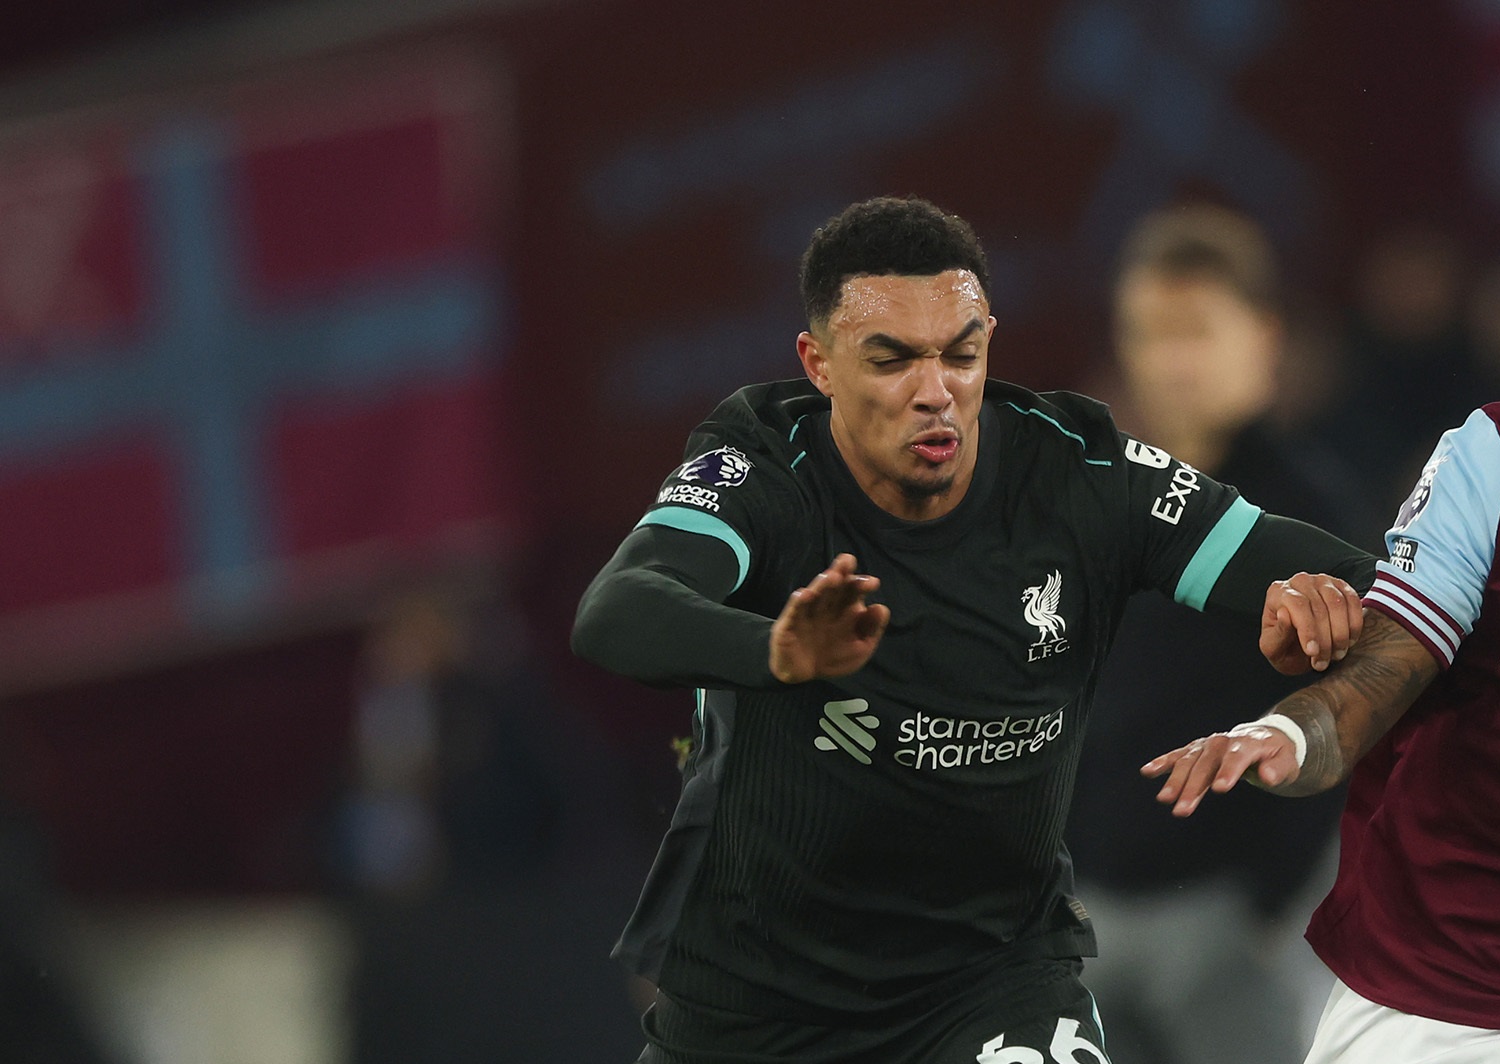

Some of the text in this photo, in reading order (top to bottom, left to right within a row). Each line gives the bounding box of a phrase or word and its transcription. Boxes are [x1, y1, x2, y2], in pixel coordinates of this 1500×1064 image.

[667, 494, 720, 512] racism
[673, 484, 719, 503] room
[894, 711, 1063, 770] chartered
